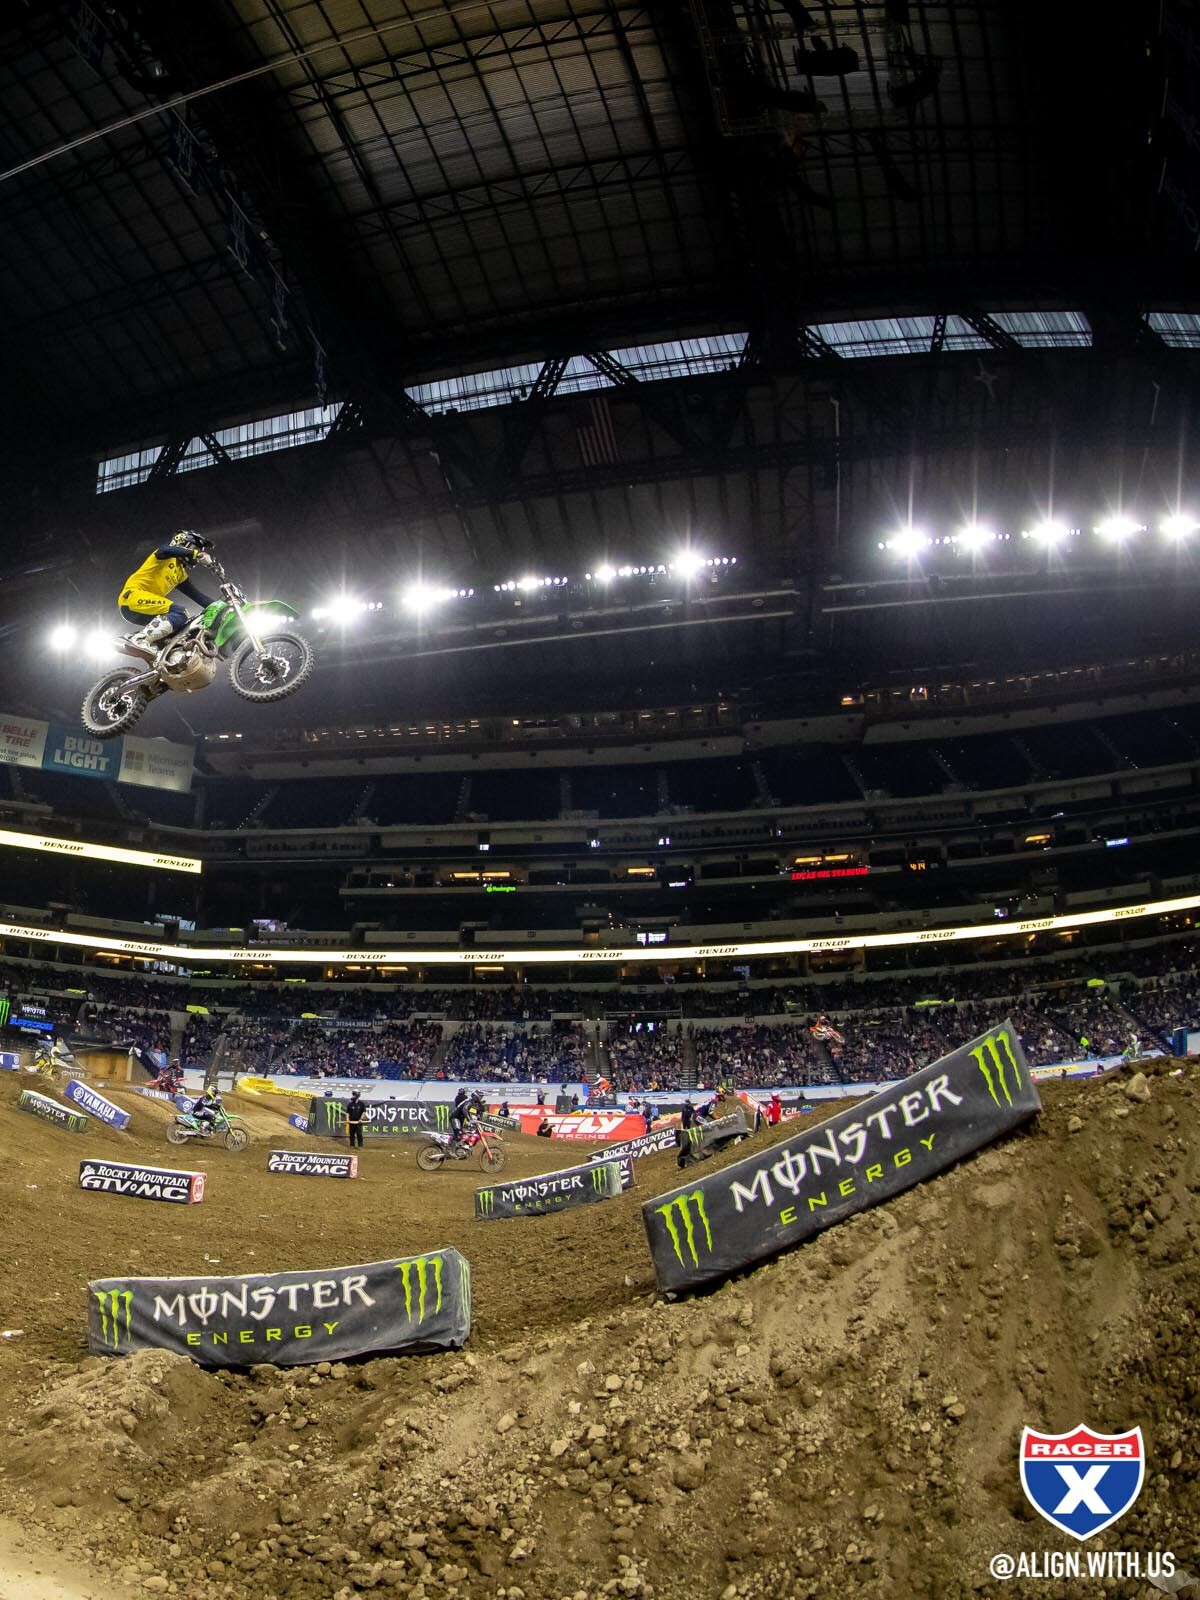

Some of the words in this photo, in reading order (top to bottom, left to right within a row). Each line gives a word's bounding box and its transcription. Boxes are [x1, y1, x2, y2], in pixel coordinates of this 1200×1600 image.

[3, 725, 38, 738] BELLE
[6, 735, 31, 747] TIRE
[64, 736, 104, 754] BUD
[54, 750, 110, 771] LIGHT
[148, 753, 188, 769] Microsoft
[43, 841, 84, 852] DUNLOP
[156, 858, 194, 868] DUNLOP
[1115, 907, 1146, 917] DUNLOP
[9, 927, 50, 938] DUNLOP
[1020, 920, 1054, 930] DUNLOP
[920, 931, 956, 940] DUNLOP
[123, 942, 162, 952] DUNLOP
[812, 940, 850, 948] DUNLOP
[22, 1005, 46, 1016] MONSTER
[30, 1099, 66, 1120] MONSTER
[82, 1094, 115, 1119] YAMAHA
[365, 1104, 430, 1127] ONSTER
[362, 1125, 417, 1133] ENERGY
[540, 1117, 625, 1134] FLY
[602, 1142, 631, 1158] ROCKY
[631, 1127, 675, 1150] MOUNTAIN
[729, 1074, 962, 1213] MONSTER
[281, 1154, 307, 1163] ROCKY
[307, 1155, 349, 1165] MOUNTAIN
[97, 1166, 130, 1180] ROCKY
[131, 1170, 189, 1187] MOUNTAIN
[780, 1133, 937, 1226] ENERGY
[502, 1175, 584, 1202] MONSTER
[515, 1194, 571, 1211] ENERGY
[153, 1275, 376, 1325] MONSTER
[186, 1321, 339, 1346] ENERGY
